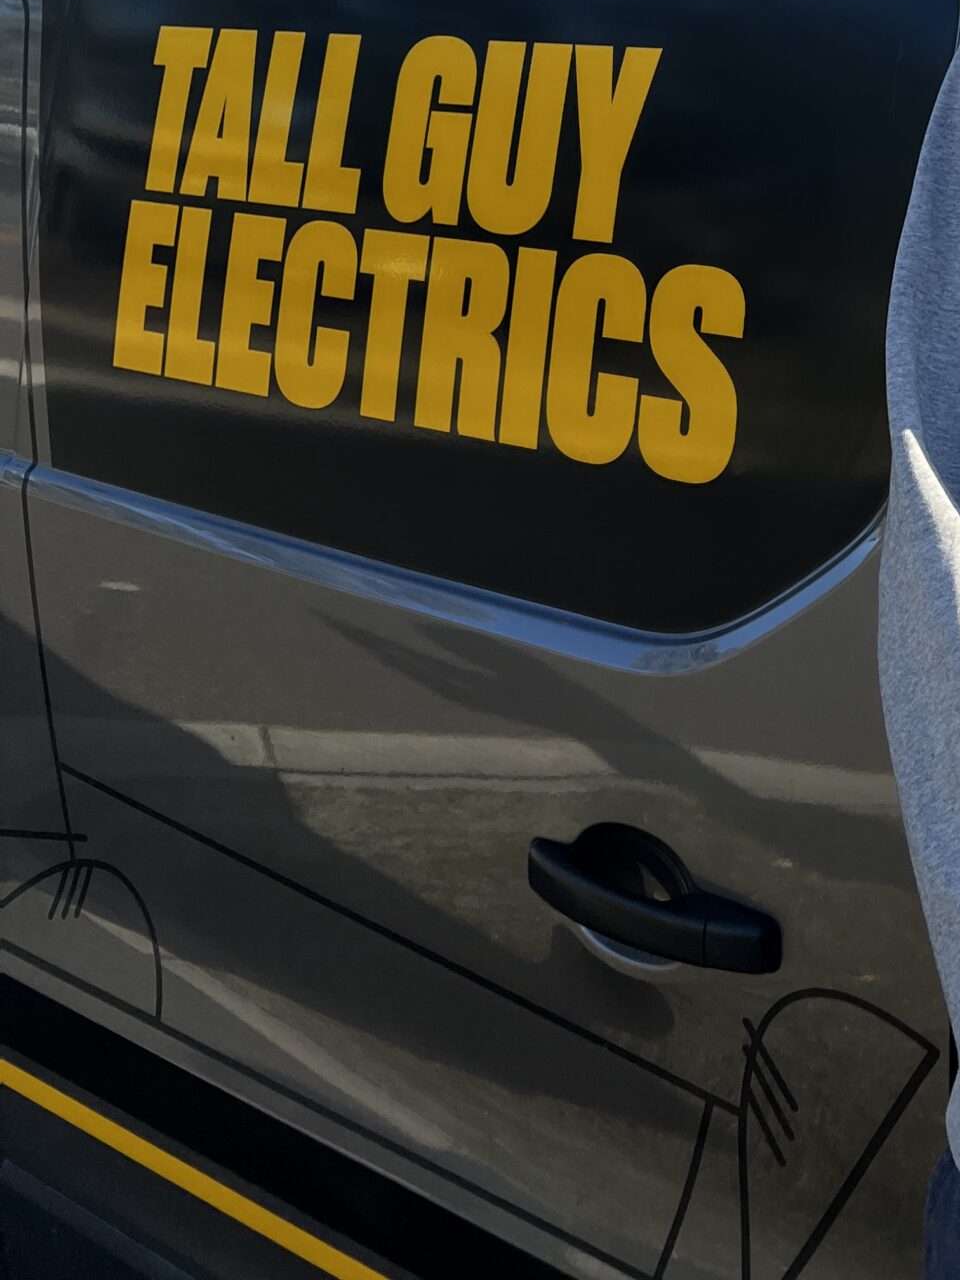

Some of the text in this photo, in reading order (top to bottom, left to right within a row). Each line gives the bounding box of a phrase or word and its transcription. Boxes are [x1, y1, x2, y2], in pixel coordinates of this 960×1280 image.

[145, 25, 663, 243] TALL GUY
[113, 199, 746, 484] ELECTRICS
